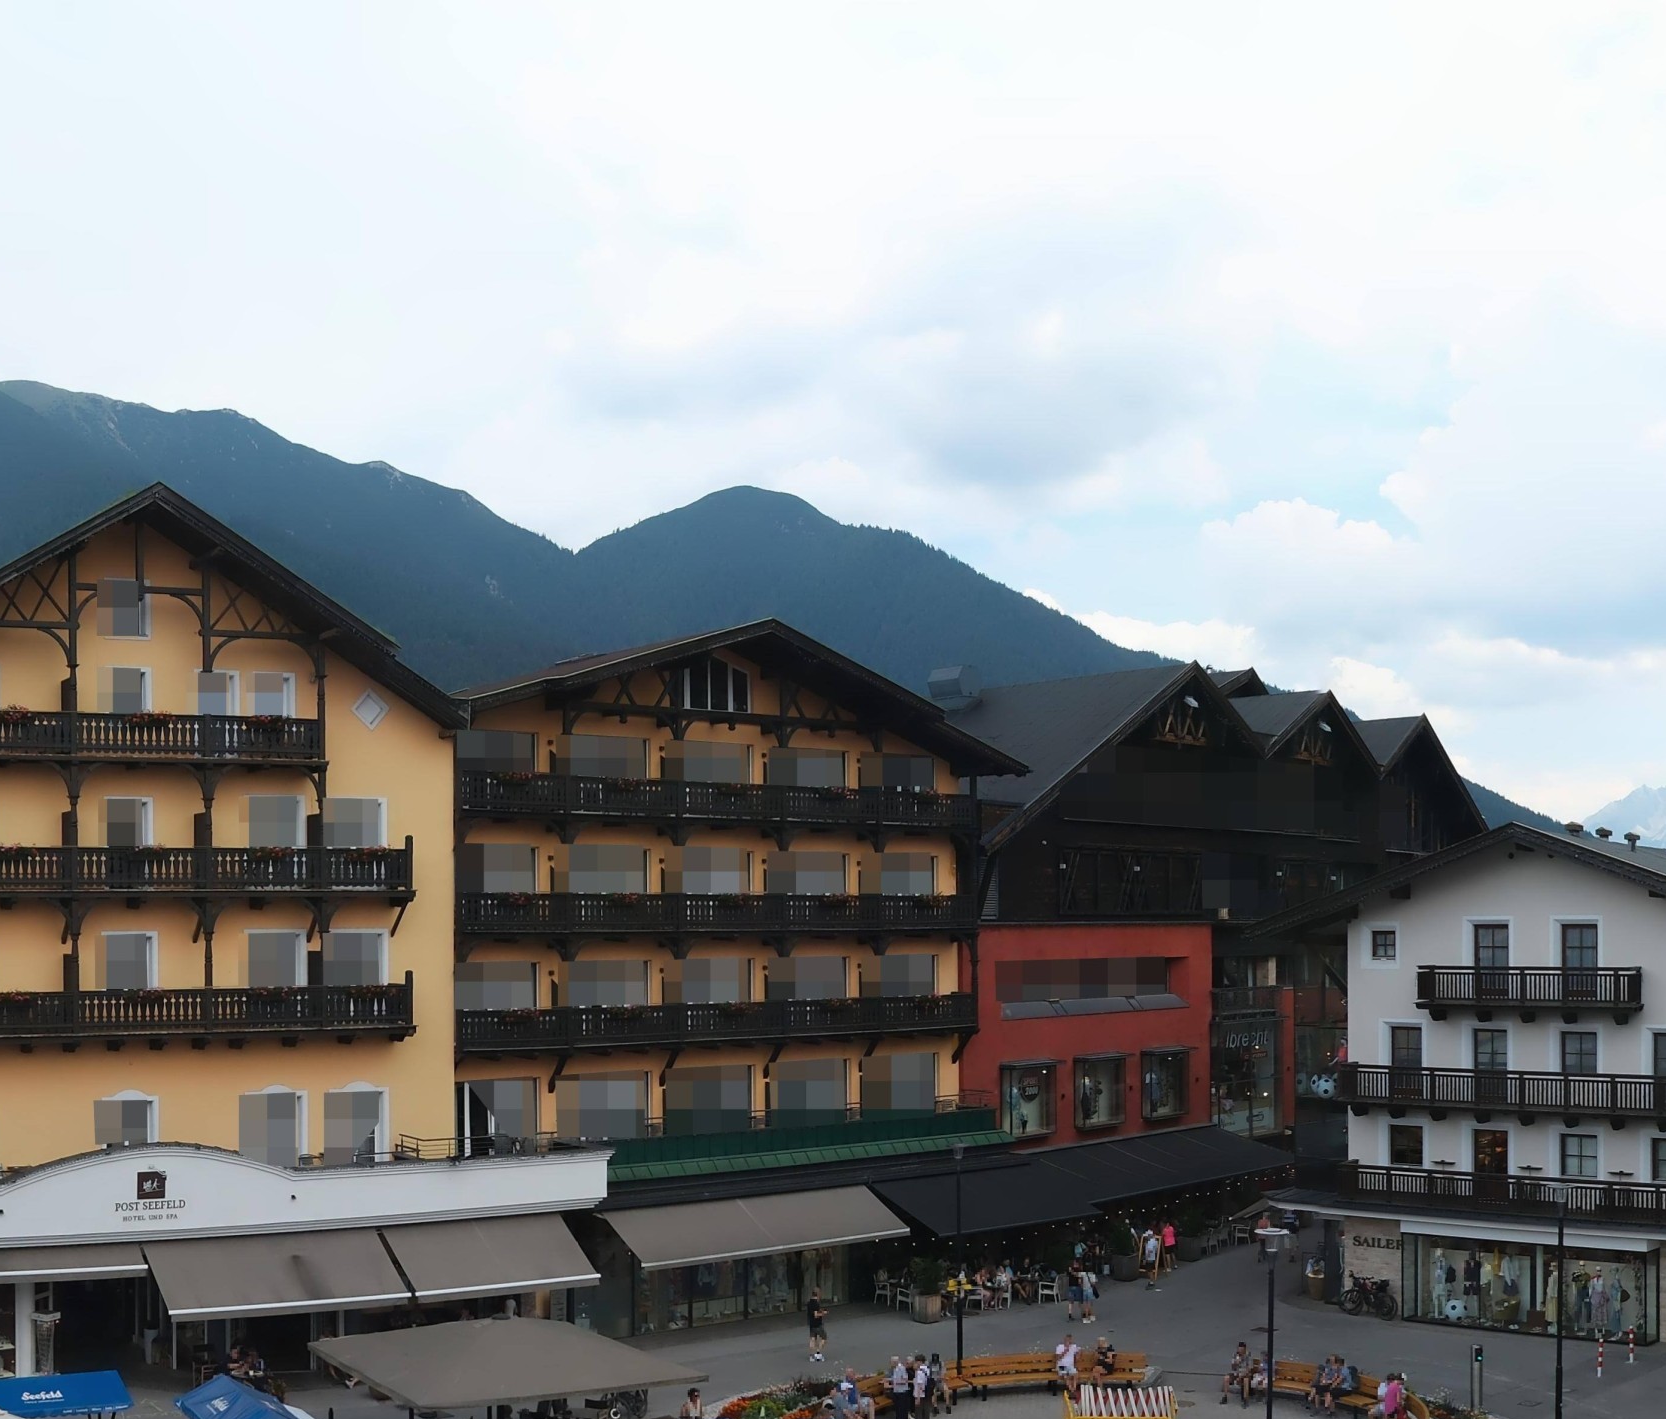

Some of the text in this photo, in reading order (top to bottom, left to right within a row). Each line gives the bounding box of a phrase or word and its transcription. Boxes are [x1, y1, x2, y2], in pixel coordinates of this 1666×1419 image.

[115, 1199, 186, 1212] POST SEEFELD
[21, 1389, 63, 1402] Seefeld
